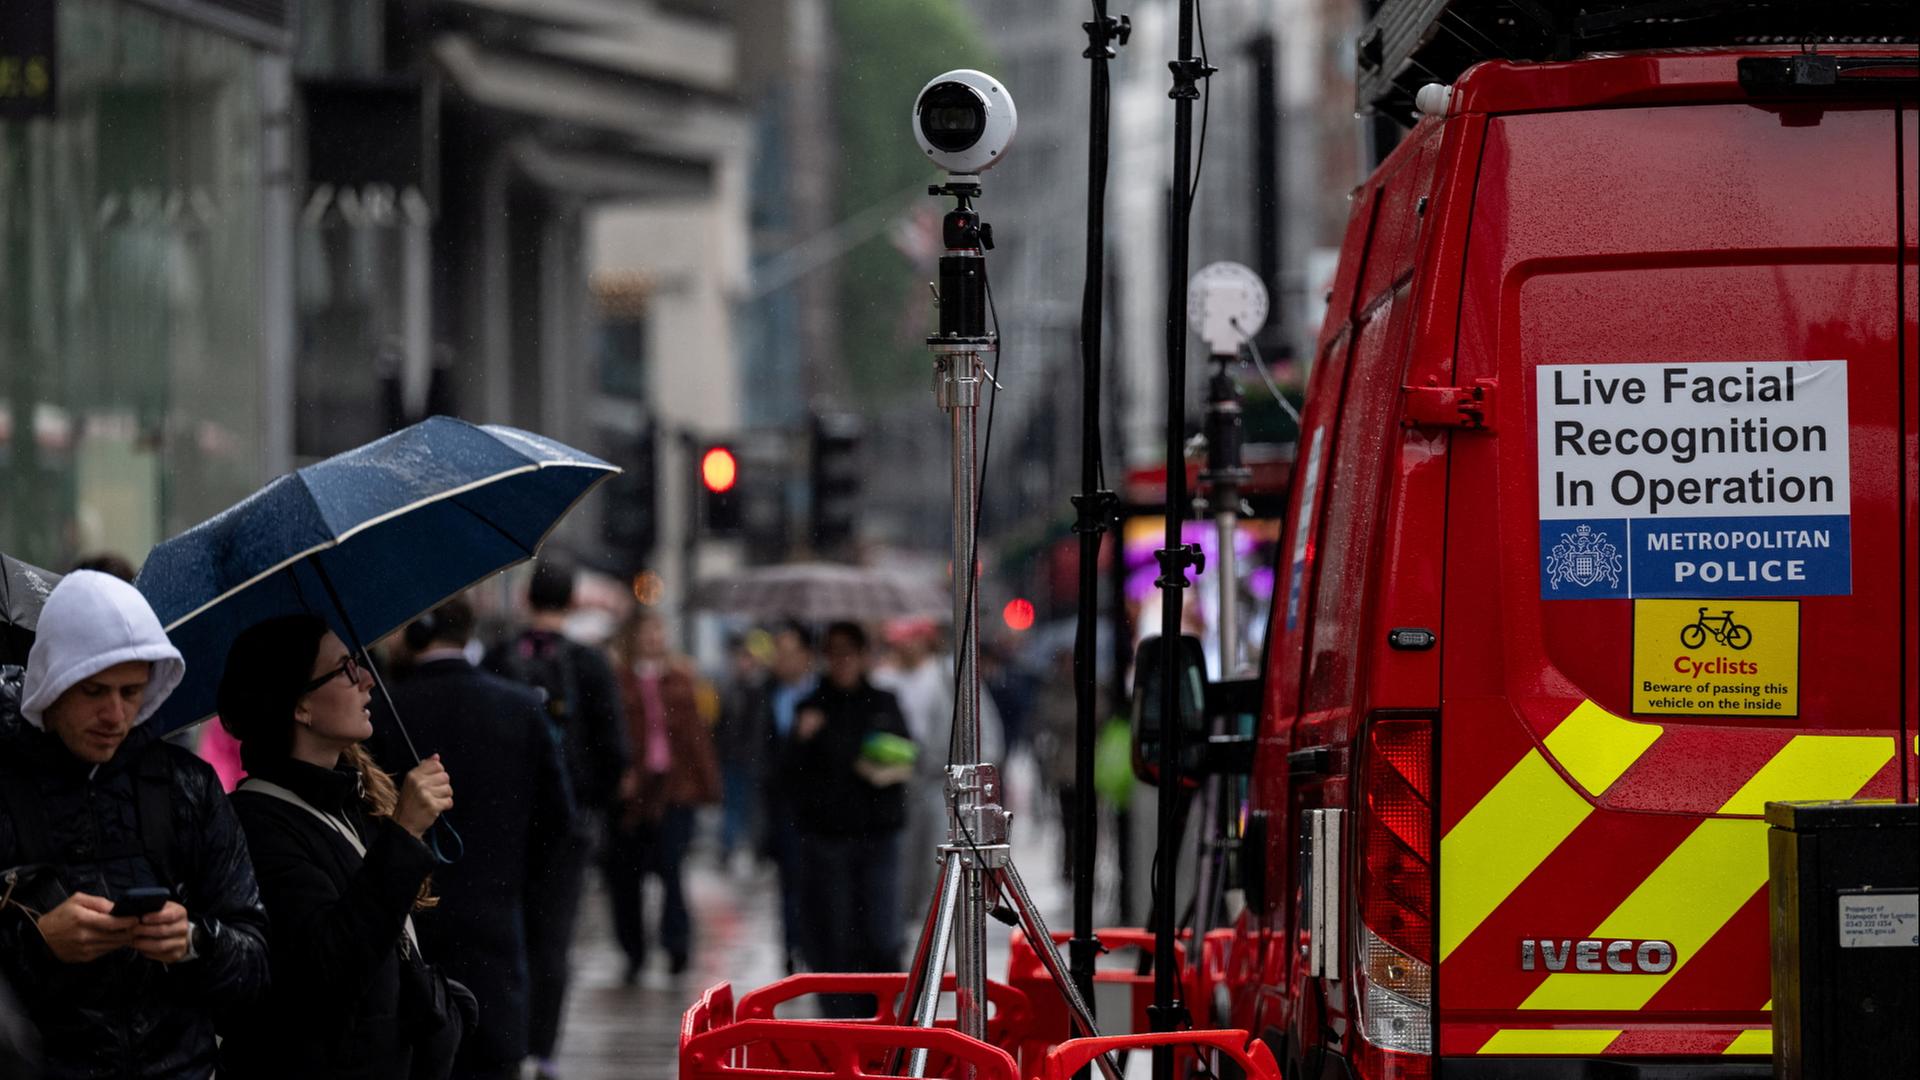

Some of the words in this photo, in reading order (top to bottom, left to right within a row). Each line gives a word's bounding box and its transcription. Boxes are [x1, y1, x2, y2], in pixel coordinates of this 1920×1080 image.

[1553, 369, 1647, 406] Live
[1662, 366, 1795, 404] Facial
[1553, 416, 1828, 464] Recognition
[1555, 471, 1595, 507] In
[1610, 467, 1835, 515] Operation
[1647, 530, 1831, 551] METROPOLITAN
[1674, 560, 1806, 583] POLICE
[1673, 656, 1759, 679] Cyclists
[1643, 681, 1693, 693] Beware
[1696, 682, 1711, 693] of
[1713, 683, 1761, 697] passing
[1764, 683, 1788, 695] this
[1648, 697, 1694, 709] vehicle
[1697, 701, 1715, 709] on
[1718, 698, 1741, 710] the
[1743, 698, 1782, 710] inside
[1522, 940, 1673, 973] IVECO
